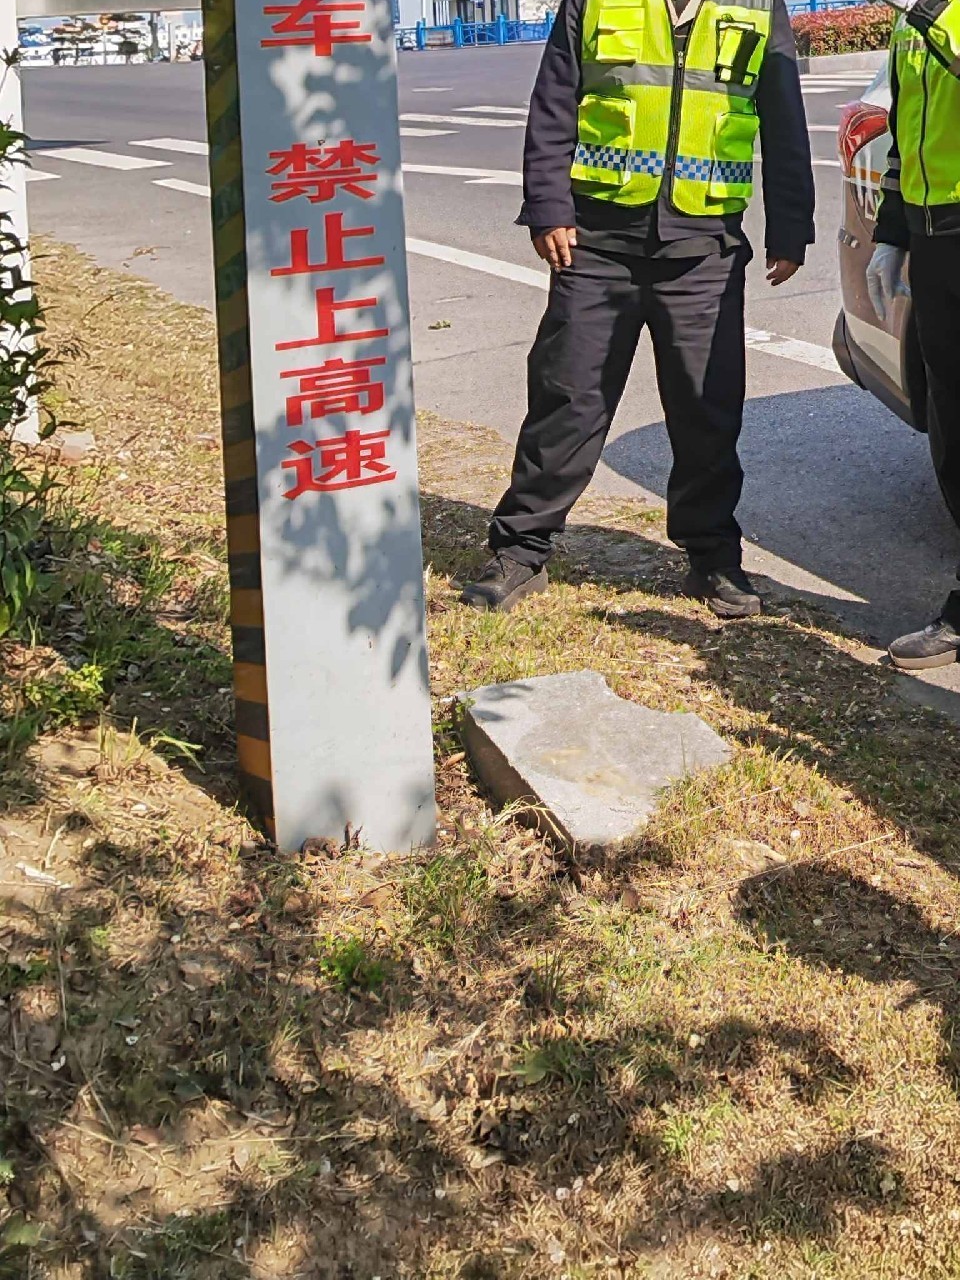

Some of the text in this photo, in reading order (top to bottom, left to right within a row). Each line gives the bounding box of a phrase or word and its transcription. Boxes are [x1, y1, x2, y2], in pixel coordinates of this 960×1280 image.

[265, 140, 397, 500] 禁止上高速
